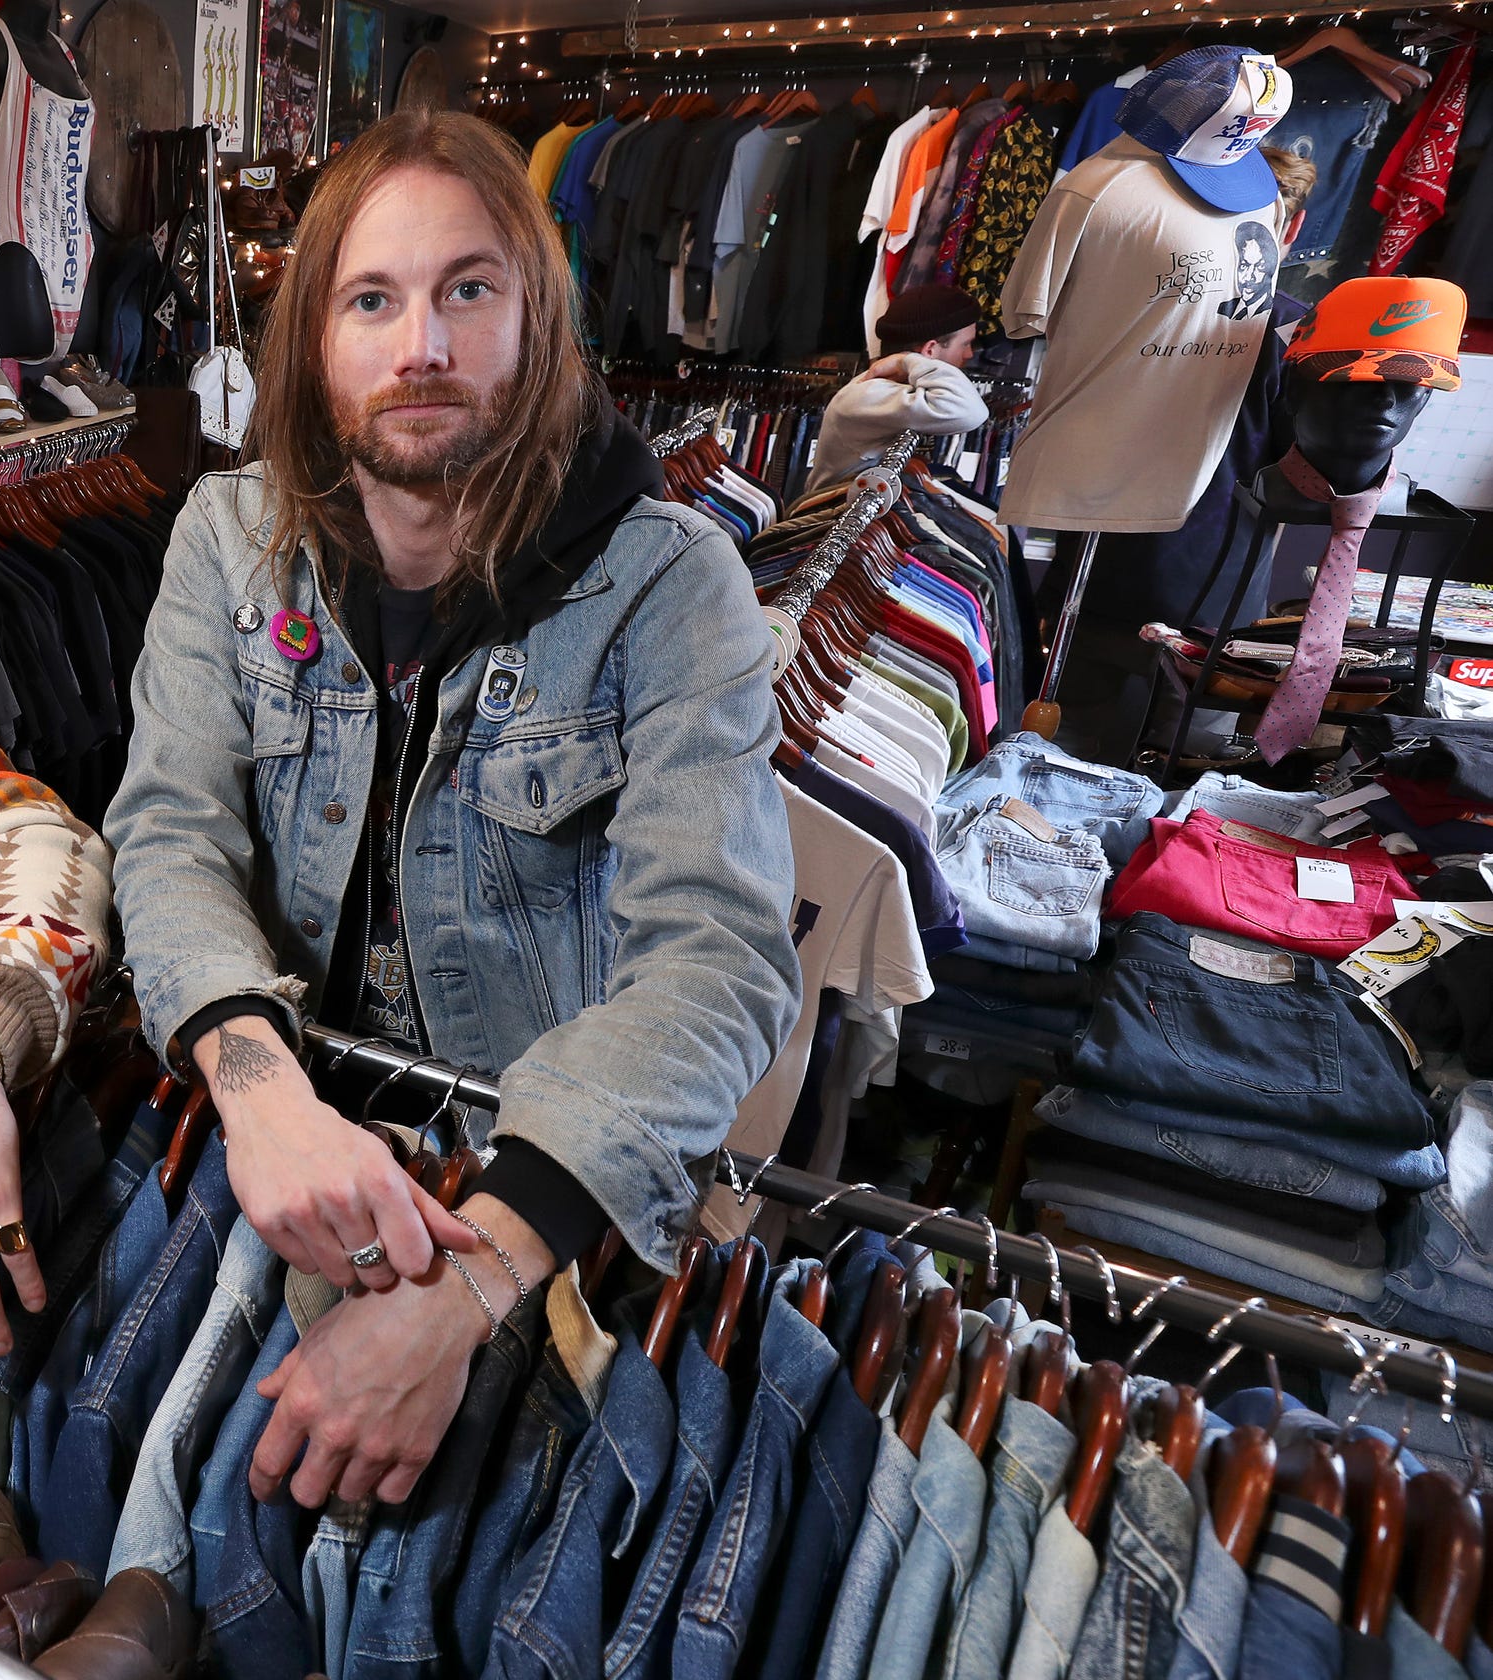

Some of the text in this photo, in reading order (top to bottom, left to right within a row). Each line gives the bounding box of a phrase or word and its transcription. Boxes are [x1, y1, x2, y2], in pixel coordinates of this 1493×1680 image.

[61, 102, 90, 296] Budweiser
[1166, 249, 1214, 276] Jesse
[1149, 266, 1223, 299] Jackson
[1381, 299, 1431, 322] PIZZA
[1140, 343, 1178, 357] Our
[1181, 341, 1213, 358] Only
[1393, 927, 1409, 940] XL
[1361, 975, 1387, 992] #14
